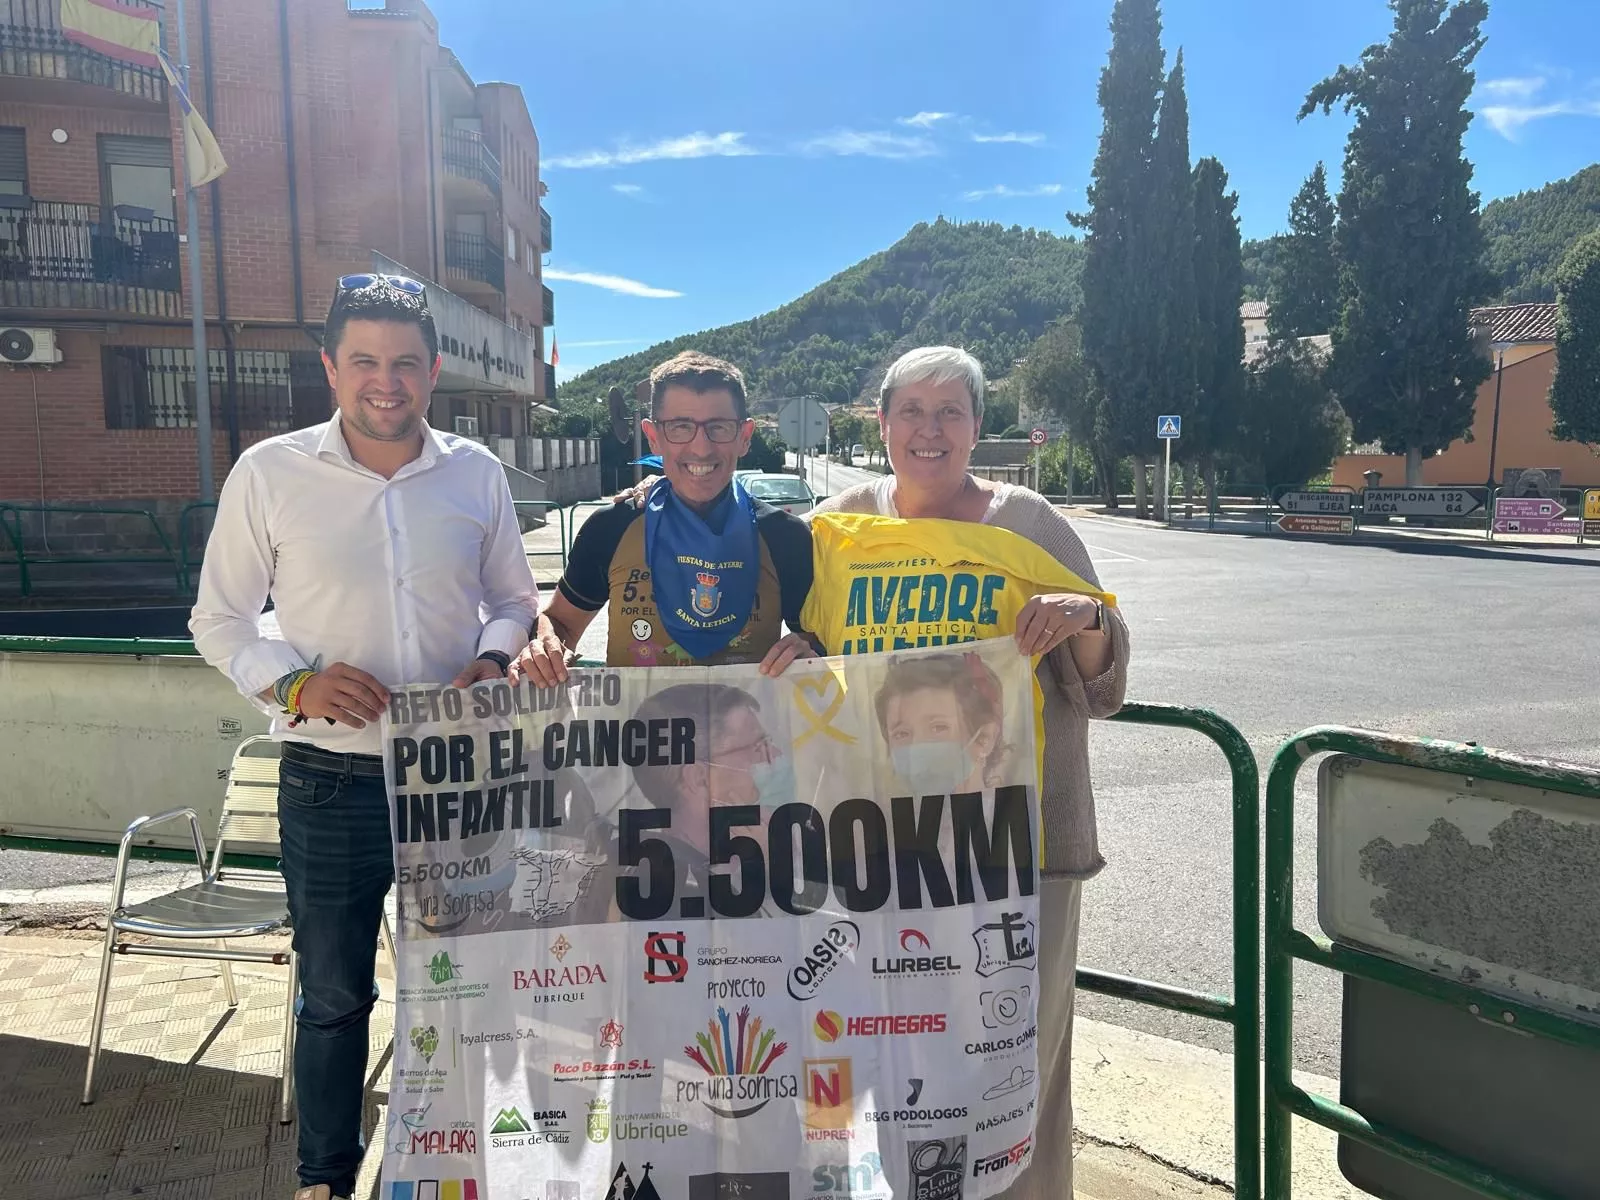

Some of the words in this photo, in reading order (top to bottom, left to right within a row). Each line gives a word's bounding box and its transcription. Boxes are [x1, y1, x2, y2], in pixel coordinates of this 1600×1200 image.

[1367, 493, 1435, 501] PAMPLONA
[1440, 493, 1463, 502] 132
[1319, 502, 1345, 511] EJEA
[1367, 504, 1398, 512] JACA
[1445, 504, 1463, 513] 64
[677, 556, 704, 567] FIESTAS
[704, 561, 716, 570] DE
[897, 558, 941, 568] FIEST
[621, 607, 639, 616] POR
[642, 607, 656, 616] EL
[675, 608, 701, 628] SANTA
[702, 614, 737, 628] LETICIA
[860, 625, 908, 637] SANTA
[918, 623, 977, 635] LETICIA
[391, 687, 463, 725] RETO
[472, 673, 621, 719] SOLIDARIO
[393, 733, 475, 786] POR
[489, 728, 529, 780] EL
[543, 717, 696, 771] CANCER
[395, 780, 562, 843] INFANTIL
[616, 785, 1035, 920] 5.500KM
[399, 856, 491, 885] 5.500KM
[697, 947, 728, 955] GRUPO
[697, 955, 783, 966] SANCHEZ-NORIEGA
[872, 955, 961, 974] LURBEL
[513, 964, 607, 990] BARADA
[534, 992, 585, 1003] UBRIQUE
[846, 1013, 946, 1036] HEMEGAS
[516, 1028, 539, 1039] S.A.
[965, 1038, 1014, 1055] CARLOS
[554, 1063, 580, 1074] Paco
[582, 1060, 626, 1073] Bazán
[628, 1058, 656, 1070] S.L.
[708, 1076, 734, 1100] una
[533, 1110, 567, 1120] BASICA
[864, 1111, 890, 1122] B&G
[893, 1107, 968, 1121] PODOLOGOS
[615, 1122, 689, 1144] Ubrique
[806, 1128, 856, 1141] NUPREN
[411, 1129, 477, 1154] MALAKA
[492, 1137, 525, 1148] Sierra
[528, 1134, 542, 1145] de
